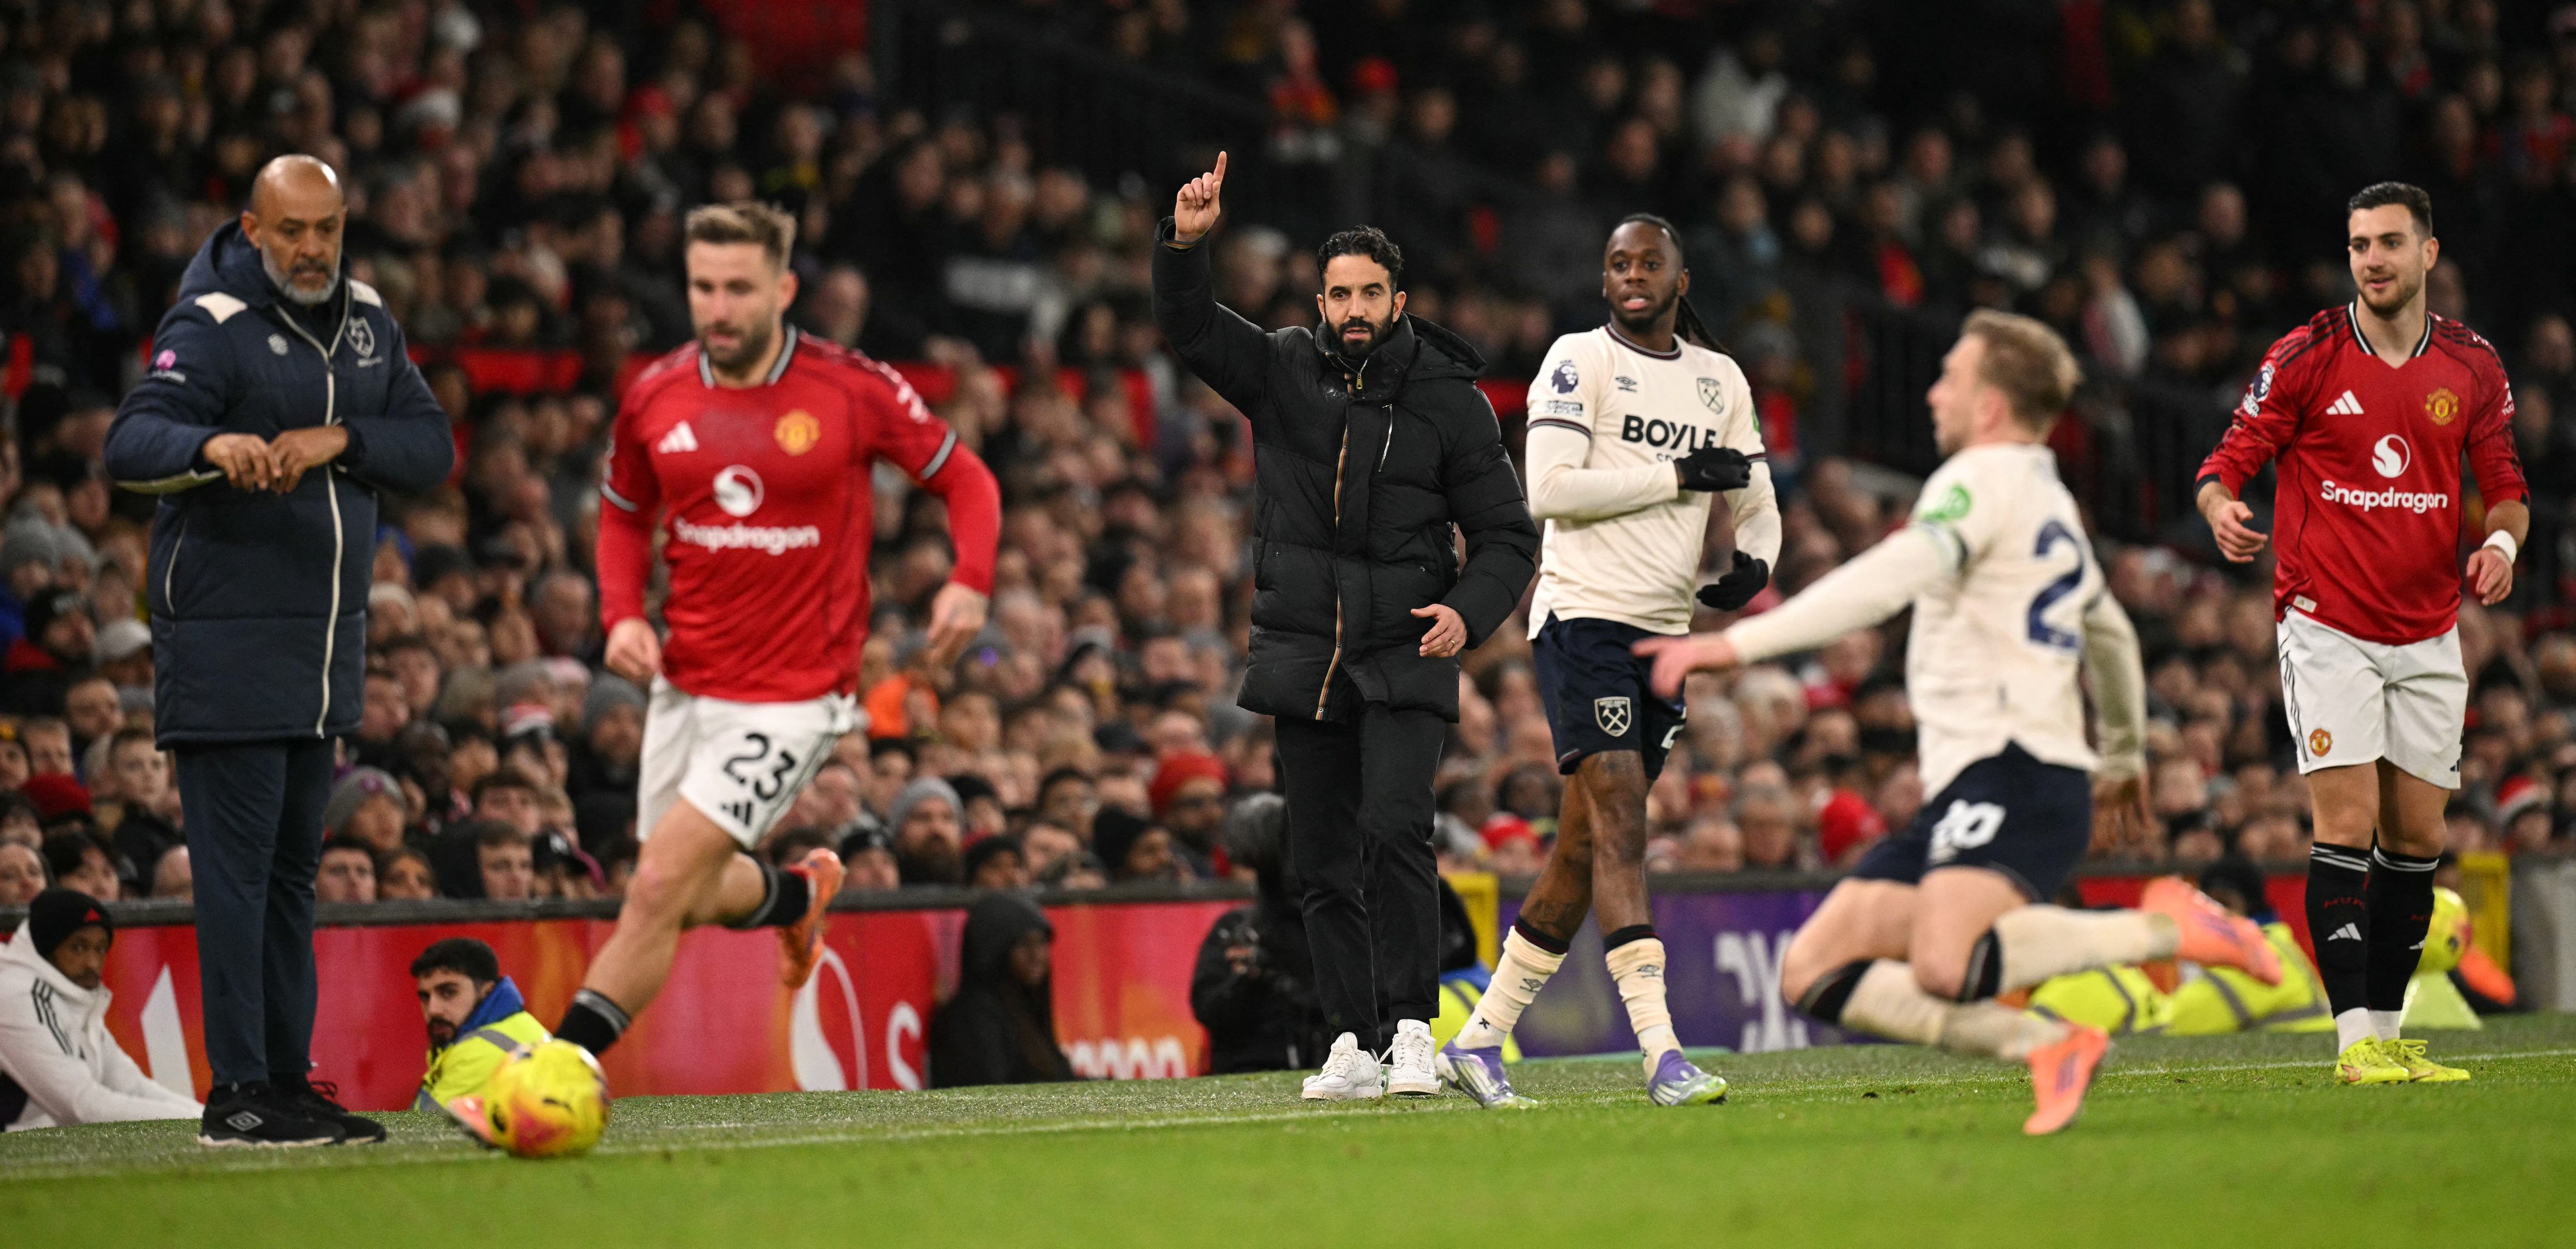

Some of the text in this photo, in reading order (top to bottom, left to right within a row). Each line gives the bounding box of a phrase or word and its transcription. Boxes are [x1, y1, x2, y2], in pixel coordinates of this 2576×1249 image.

[1622, 414, 1717, 452] BOYLE
[2321, 480, 2448, 514] Snapdragon
[722, 732, 795, 800] 23
